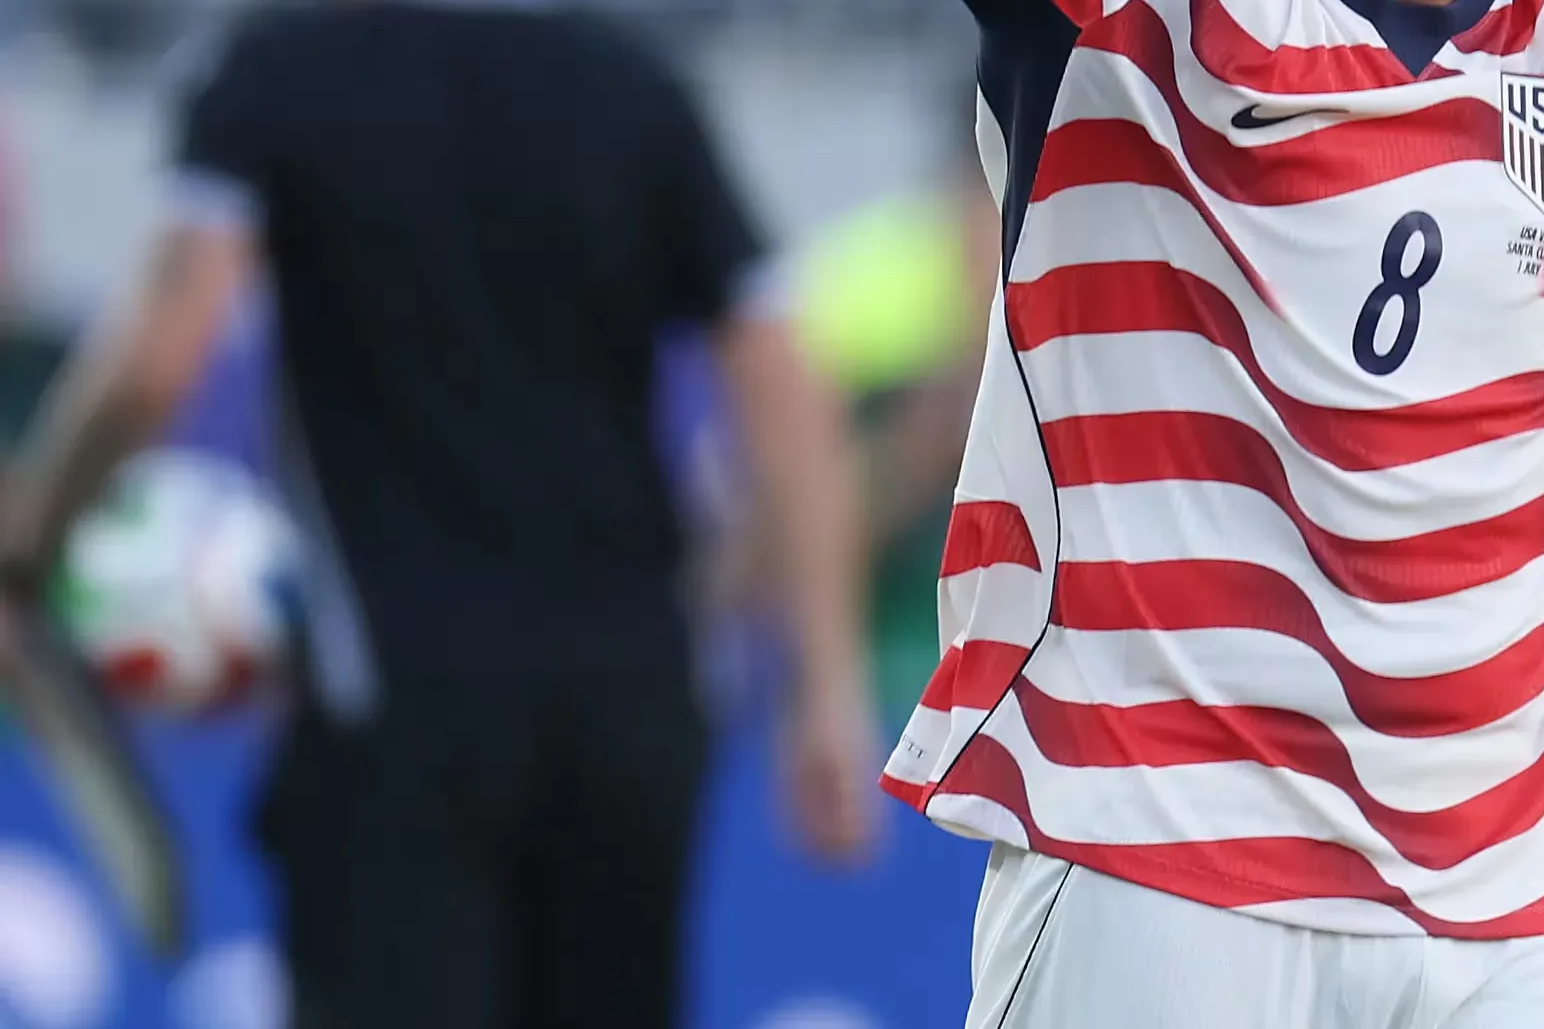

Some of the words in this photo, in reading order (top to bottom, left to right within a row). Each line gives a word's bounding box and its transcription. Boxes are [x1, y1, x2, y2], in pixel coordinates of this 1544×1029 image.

[1520, 226, 1537, 241] USA
[1506, 241, 1533, 258] SANTA
[1351, 210, 1444, 376] 8
